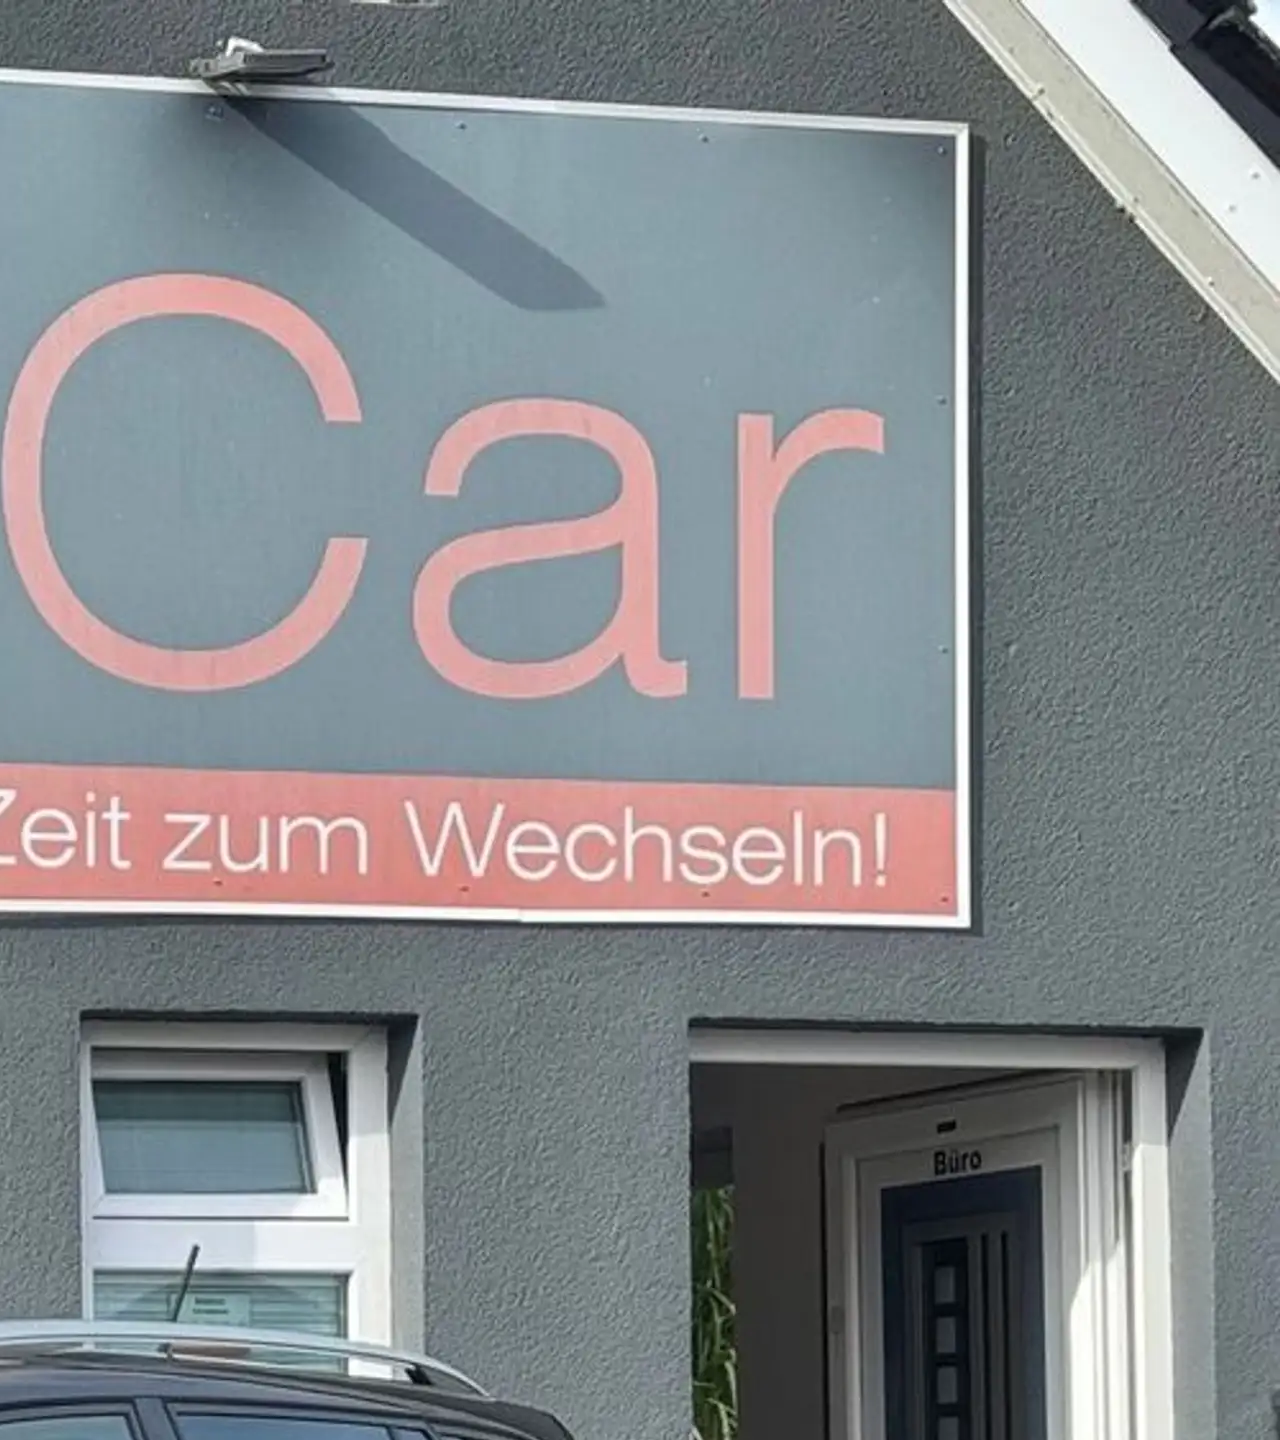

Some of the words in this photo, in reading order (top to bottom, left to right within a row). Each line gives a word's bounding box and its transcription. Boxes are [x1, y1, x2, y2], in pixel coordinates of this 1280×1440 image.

[162, 812, 369, 876] zum
[403, 799, 890, 888] Wechseln!
[934, 1150, 982, 1176] Büro
